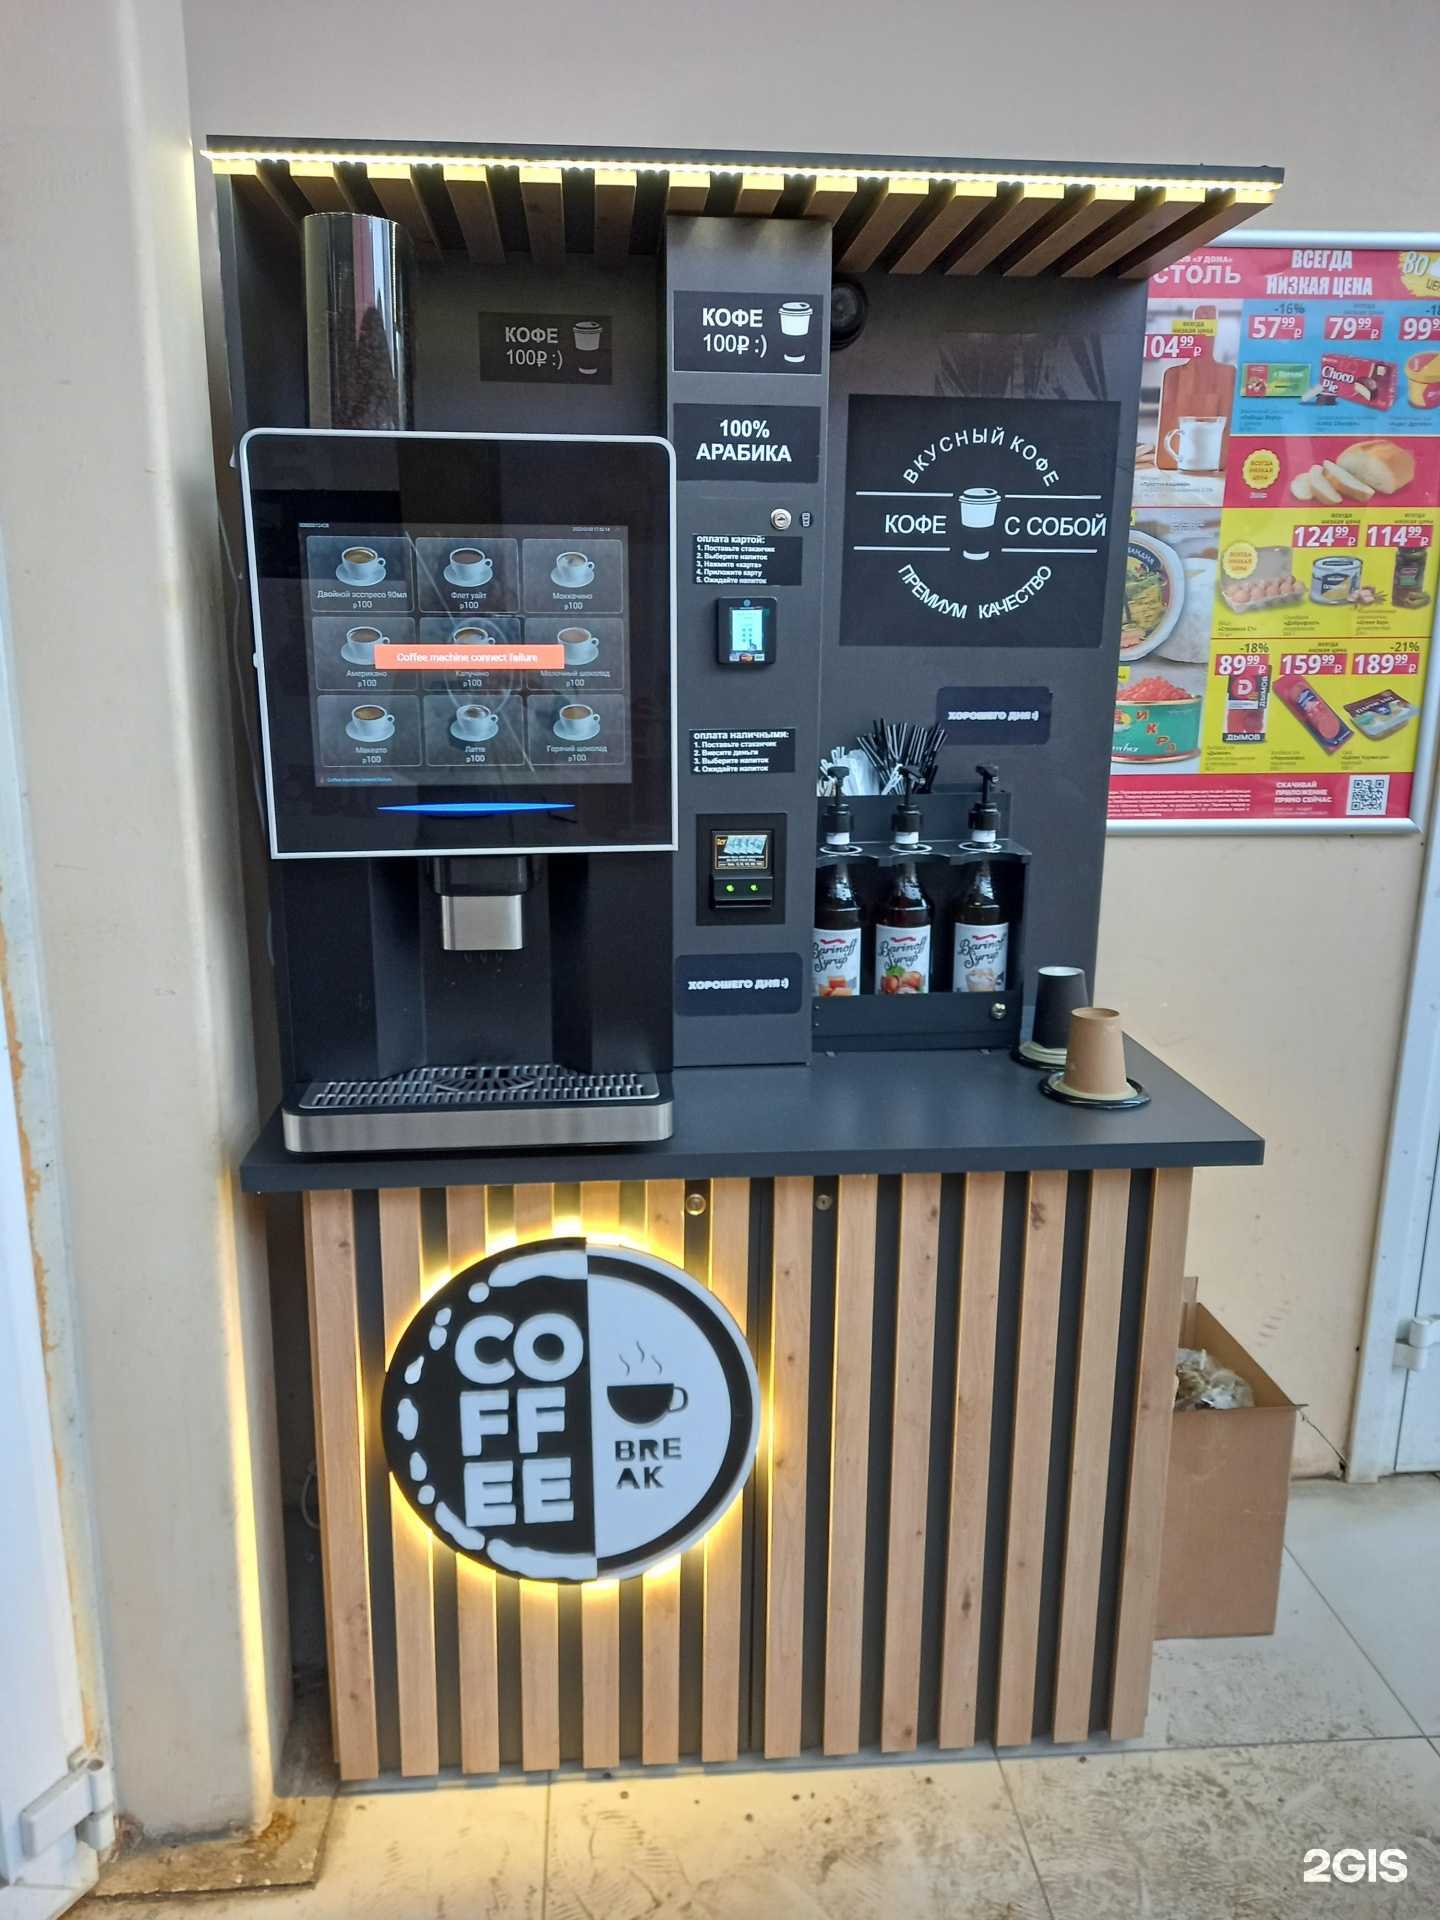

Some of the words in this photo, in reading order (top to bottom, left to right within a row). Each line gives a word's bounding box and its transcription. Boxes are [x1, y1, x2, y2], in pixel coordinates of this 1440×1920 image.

[1292, 250, 1353, 272] ВСЕГДА
[1332, 276, 1373, 298] ЦЕНА
[702, 308, 764, 328] КОФЕ
[1252, 316, 1281, 338] 57
[1328, 317, 1358, 339] 79
[505, 326, 559, 344] КОФЕ
[1321, 365, 1355, 384] Choco
[1322, 378, 1339, 394] Pie
[720, 419, 770, 438] 100%
[696, 443, 792, 462] АРАБИКА
[903, 427, 1005, 484] ВКУСНЫЙ
[1009, 435, 1060, 487] КОФЕ
[885, 514, 947, 534] КОФЕ
[1004, 516, 1021, 536] С
[1026, 513, 1107, 537] СОБОЙ
[730, 536, 766, 545] картой:
[1294, 526, 1335, 546] 124
[1368, 526, 1408, 546] 114
[317, 590, 350, 600] Двойной
[898, 564, 968, 618] ПРЕМИУМ
[978, 565, 1051, 620] КАЧЕСТВО
[1240, 643, 1270, 654] -18%
[1390, 641, 1420, 652] -21%
[397, 652, 428, 662] Coffee
[1219, 655, 1247, 676] 89
[1282, 655, 1322, 675] 159
[1354, 654, 1395, 674] 189
[730, 731, 790, 739] наличными:
[688, 980, 753, 990] ХОРОШЕГО
